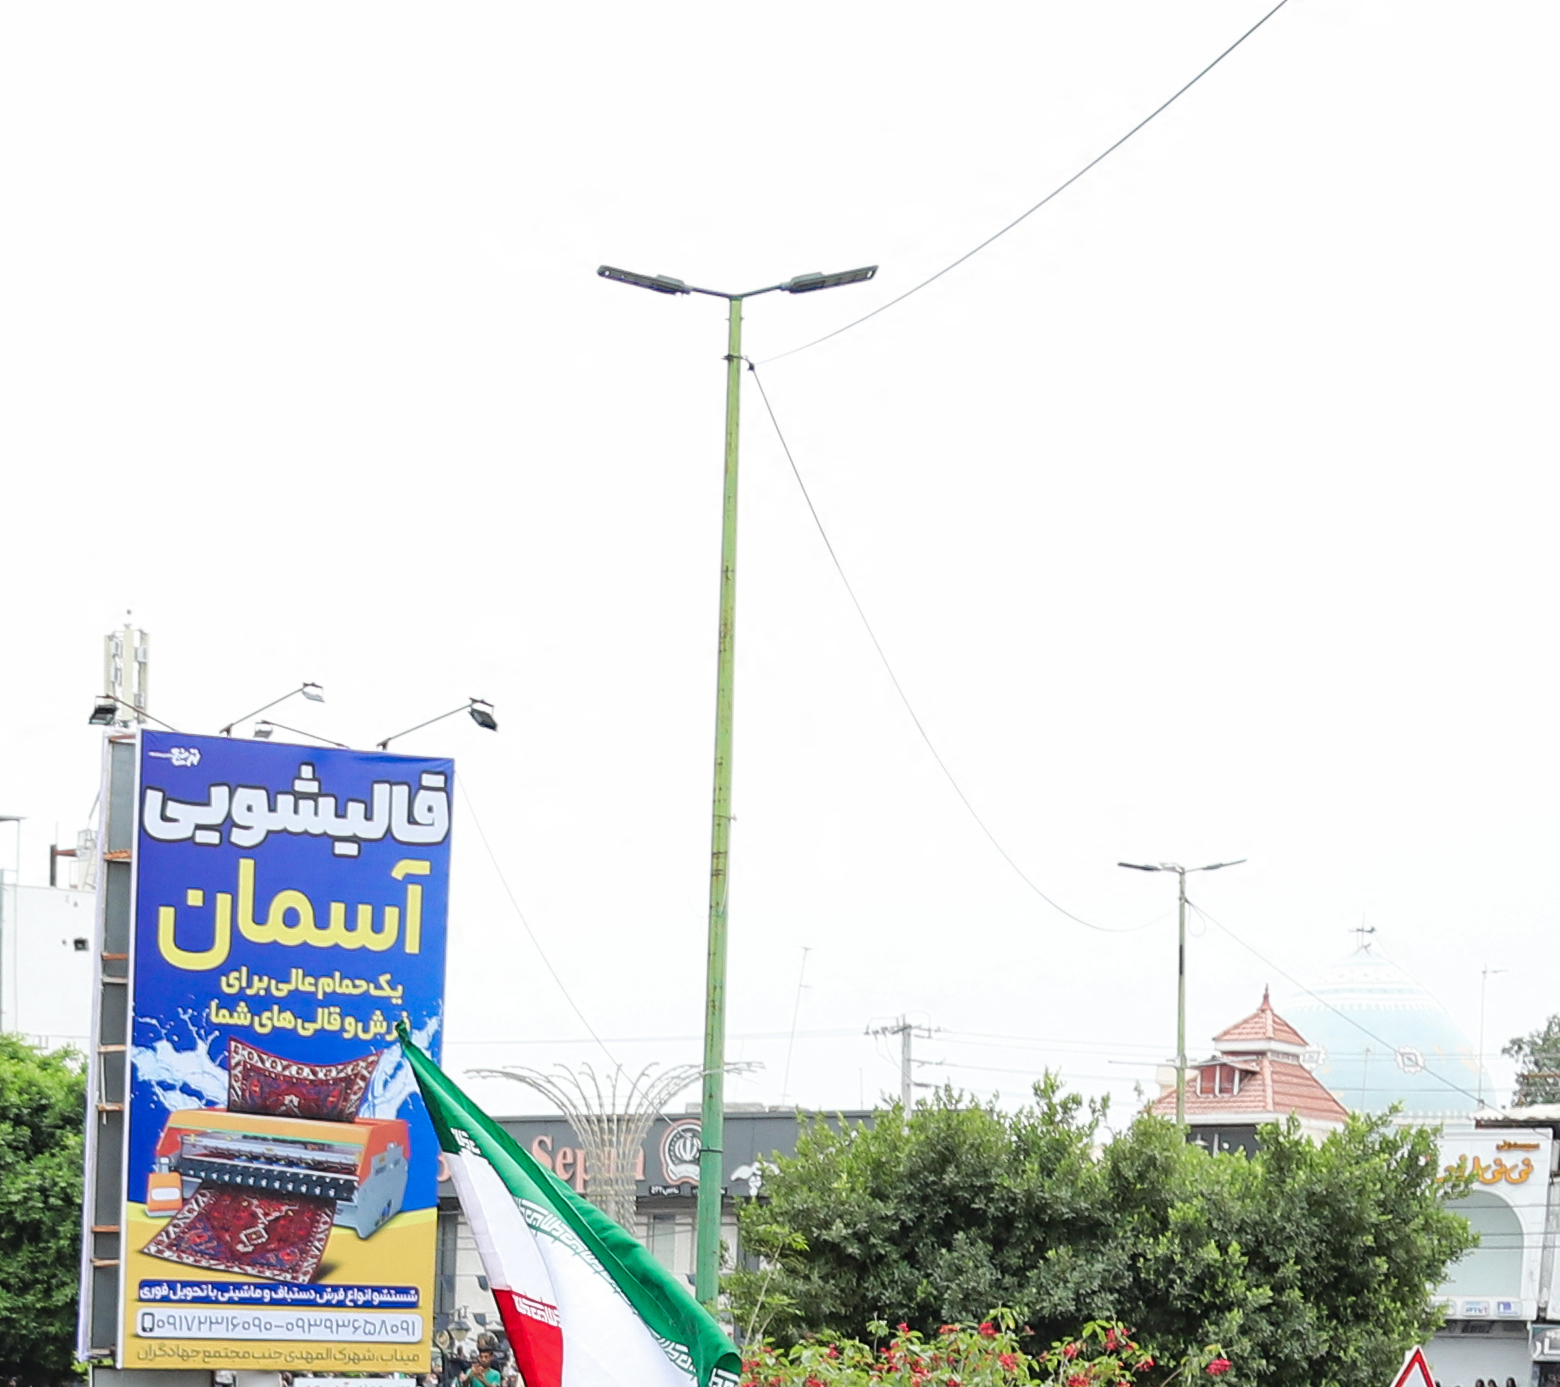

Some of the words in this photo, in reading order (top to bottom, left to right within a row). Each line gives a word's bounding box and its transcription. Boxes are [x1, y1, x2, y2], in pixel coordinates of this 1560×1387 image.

[144, 762, 449, 857] قالیشویی
[158, 858, 431, 970] آسمان
[221, 966, 268, 996] برای
[270, 969, 316, 997] عالی
[318, 970, 369, 1000] حمام
[370, 973, 404, 1004] یک
[210, 1001, 252, 1027] شما
[253, 1005, 295, 1034] های
[296, 1006, 341, 1035] قالی
[343, 1017, 356, 1038] و
[531, 1135, 645, 1193] Seph
[139, 1283, 169, 1299] فوری
[170, 1283, 206, 1300] تحویل
[208, 1284, 217, 1300] با
[218, 1285, 262, 1301] ماشینی
[263, 1291, 270, 1302] و
[271, 1285, 315, 1302] دستباف
[316, 1287, 345, 1304] فرش
[346, 1289, 371, 1306] انواع
[372, 1289, 418, 1305] شستشو
[137, 1342, 201, 1362] جهادگران
[202, 1346, 251, 1363] مجتمع
[251, 1348, 284, 1363] جنب
[284, 1347, 333, 1364] المهدی
[334, 1347, 375, 1364] شهرک
